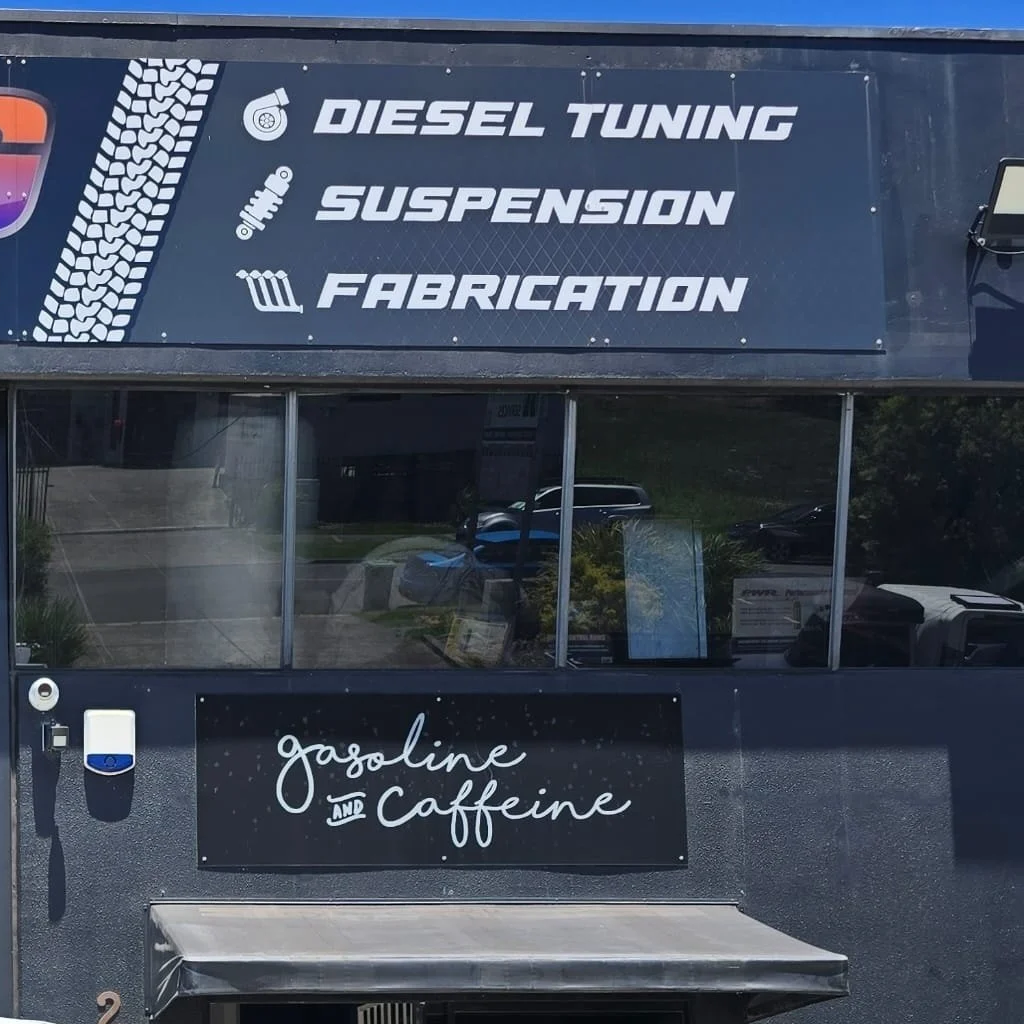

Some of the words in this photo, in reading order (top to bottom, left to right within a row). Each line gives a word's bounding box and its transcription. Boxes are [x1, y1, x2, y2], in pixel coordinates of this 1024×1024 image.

[314, 99, 546, 137] DIESEL
[567, 103, 798, 141] TUNING
[315, 185, 736, 226] SUSPENSION
[316, 273, 749, 313] FABRICATION
[276, 713, 527, 813] gasoline
[330, 797, 365, 823] AND
